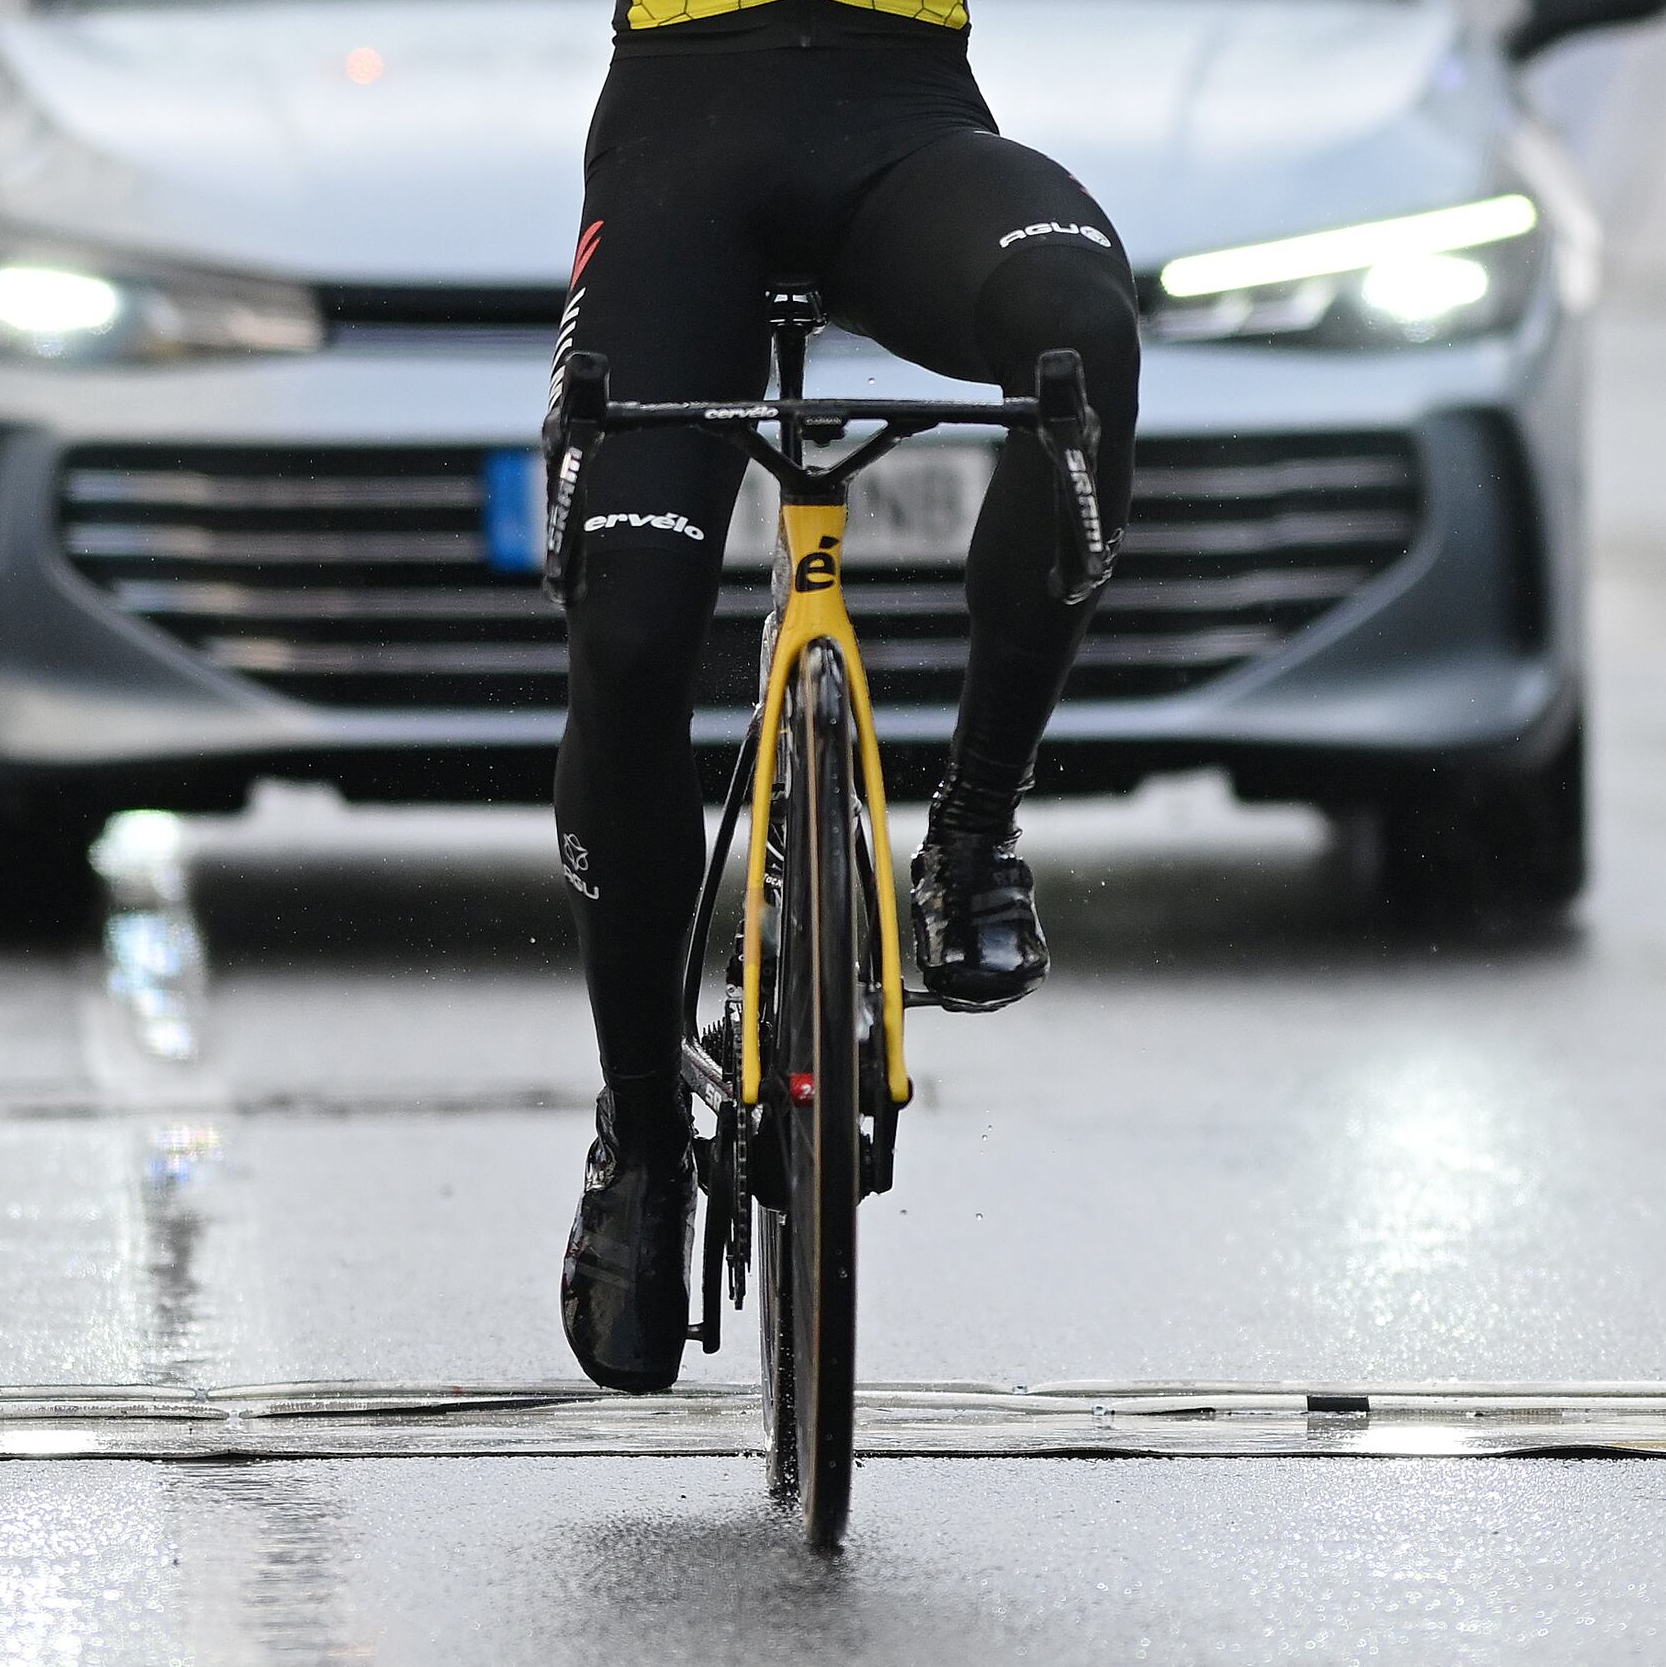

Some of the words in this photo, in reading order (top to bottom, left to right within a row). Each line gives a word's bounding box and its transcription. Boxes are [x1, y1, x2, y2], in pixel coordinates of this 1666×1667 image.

[999, 222, 1079, 248] AGU
[704, 406, 779, 420] cervélo
[1064, 448, 1103, 553] SRAM
[583, 512, 705, 541] ervélo
